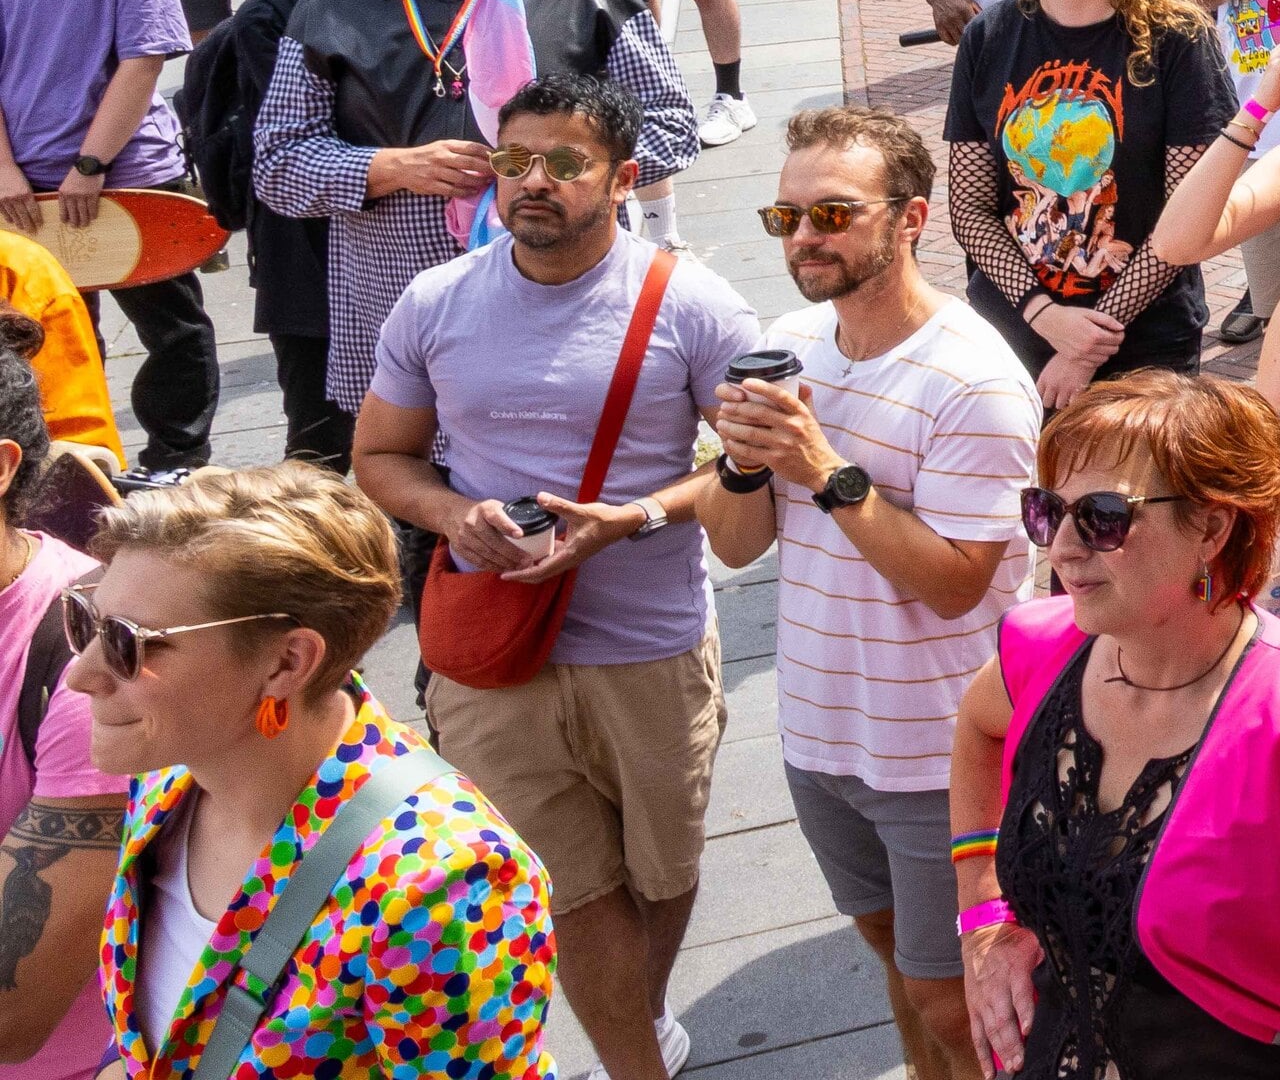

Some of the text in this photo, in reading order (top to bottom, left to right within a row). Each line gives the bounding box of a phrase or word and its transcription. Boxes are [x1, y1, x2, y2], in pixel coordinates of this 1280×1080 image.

[490, 410, 567, 420] Calvin Klein Jeans
